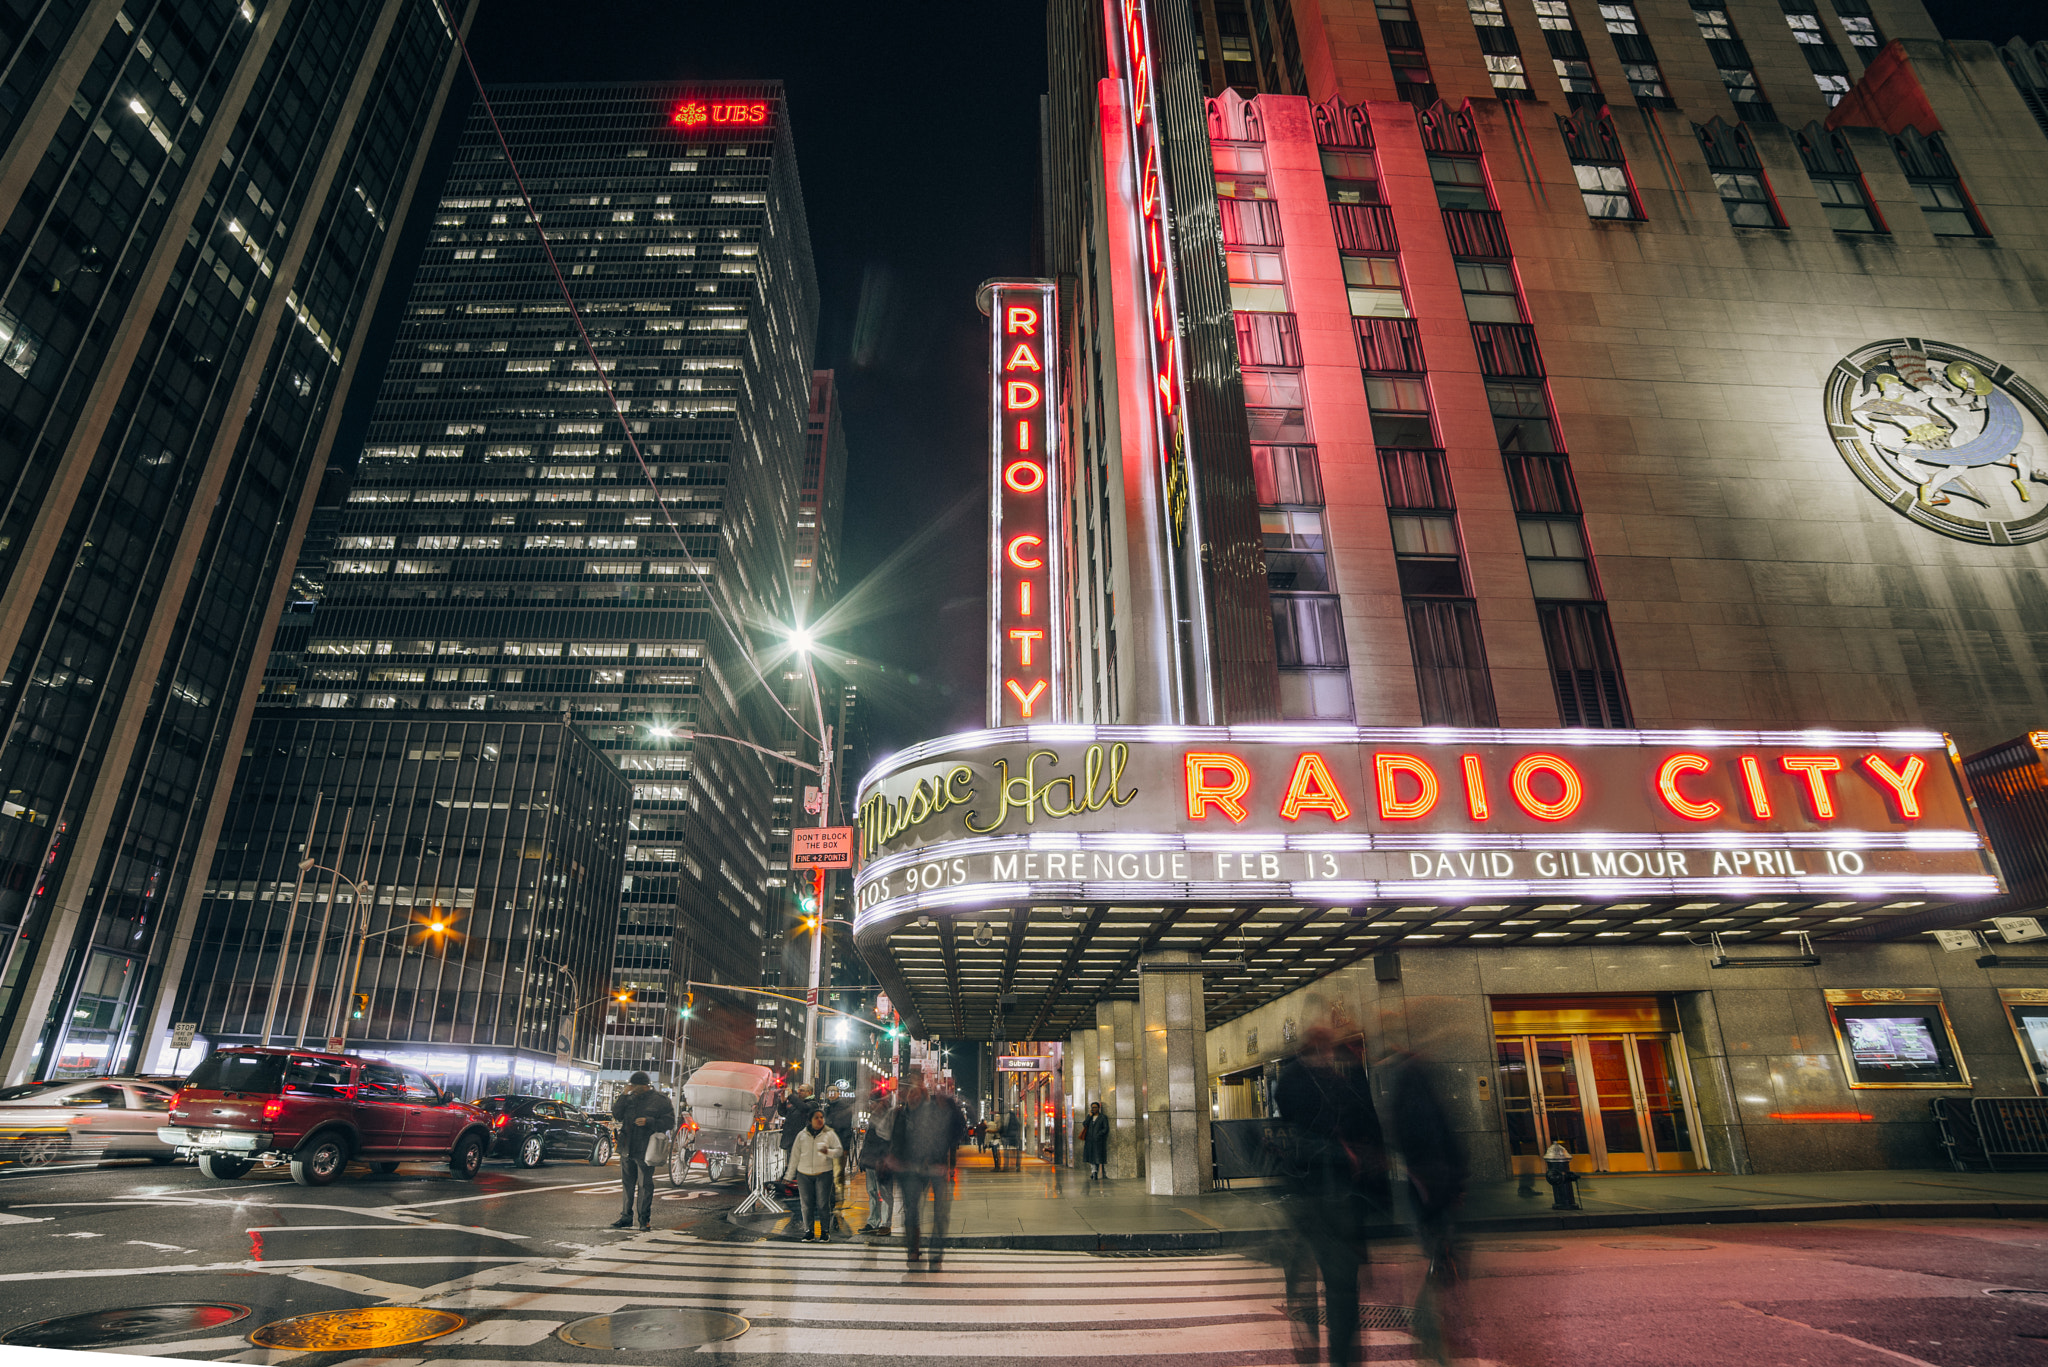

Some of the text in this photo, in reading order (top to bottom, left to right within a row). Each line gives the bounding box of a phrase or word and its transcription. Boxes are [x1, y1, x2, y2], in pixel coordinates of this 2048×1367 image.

[711, 104, 766, 122] UBS
[1004, 305, 1048, 718] RADIO CITY
[1184, 750, 1927, 823] RADIO CITY
[858, 741, 1139, 862] Music Hall
[821, 832, 848, 841] BLOCK
[822, 841, 838, 849] BOX
[797, 853, 846, 862] FINE +2 POINTS
[861, 849, 1865, 911] LOS 90'S MERENGUE FEB 13 DAVID GILMOUR APRIL 10
[1008, 1059, 1034, 1069] Subway
[828, 1089, 856, 1098] Hlton
